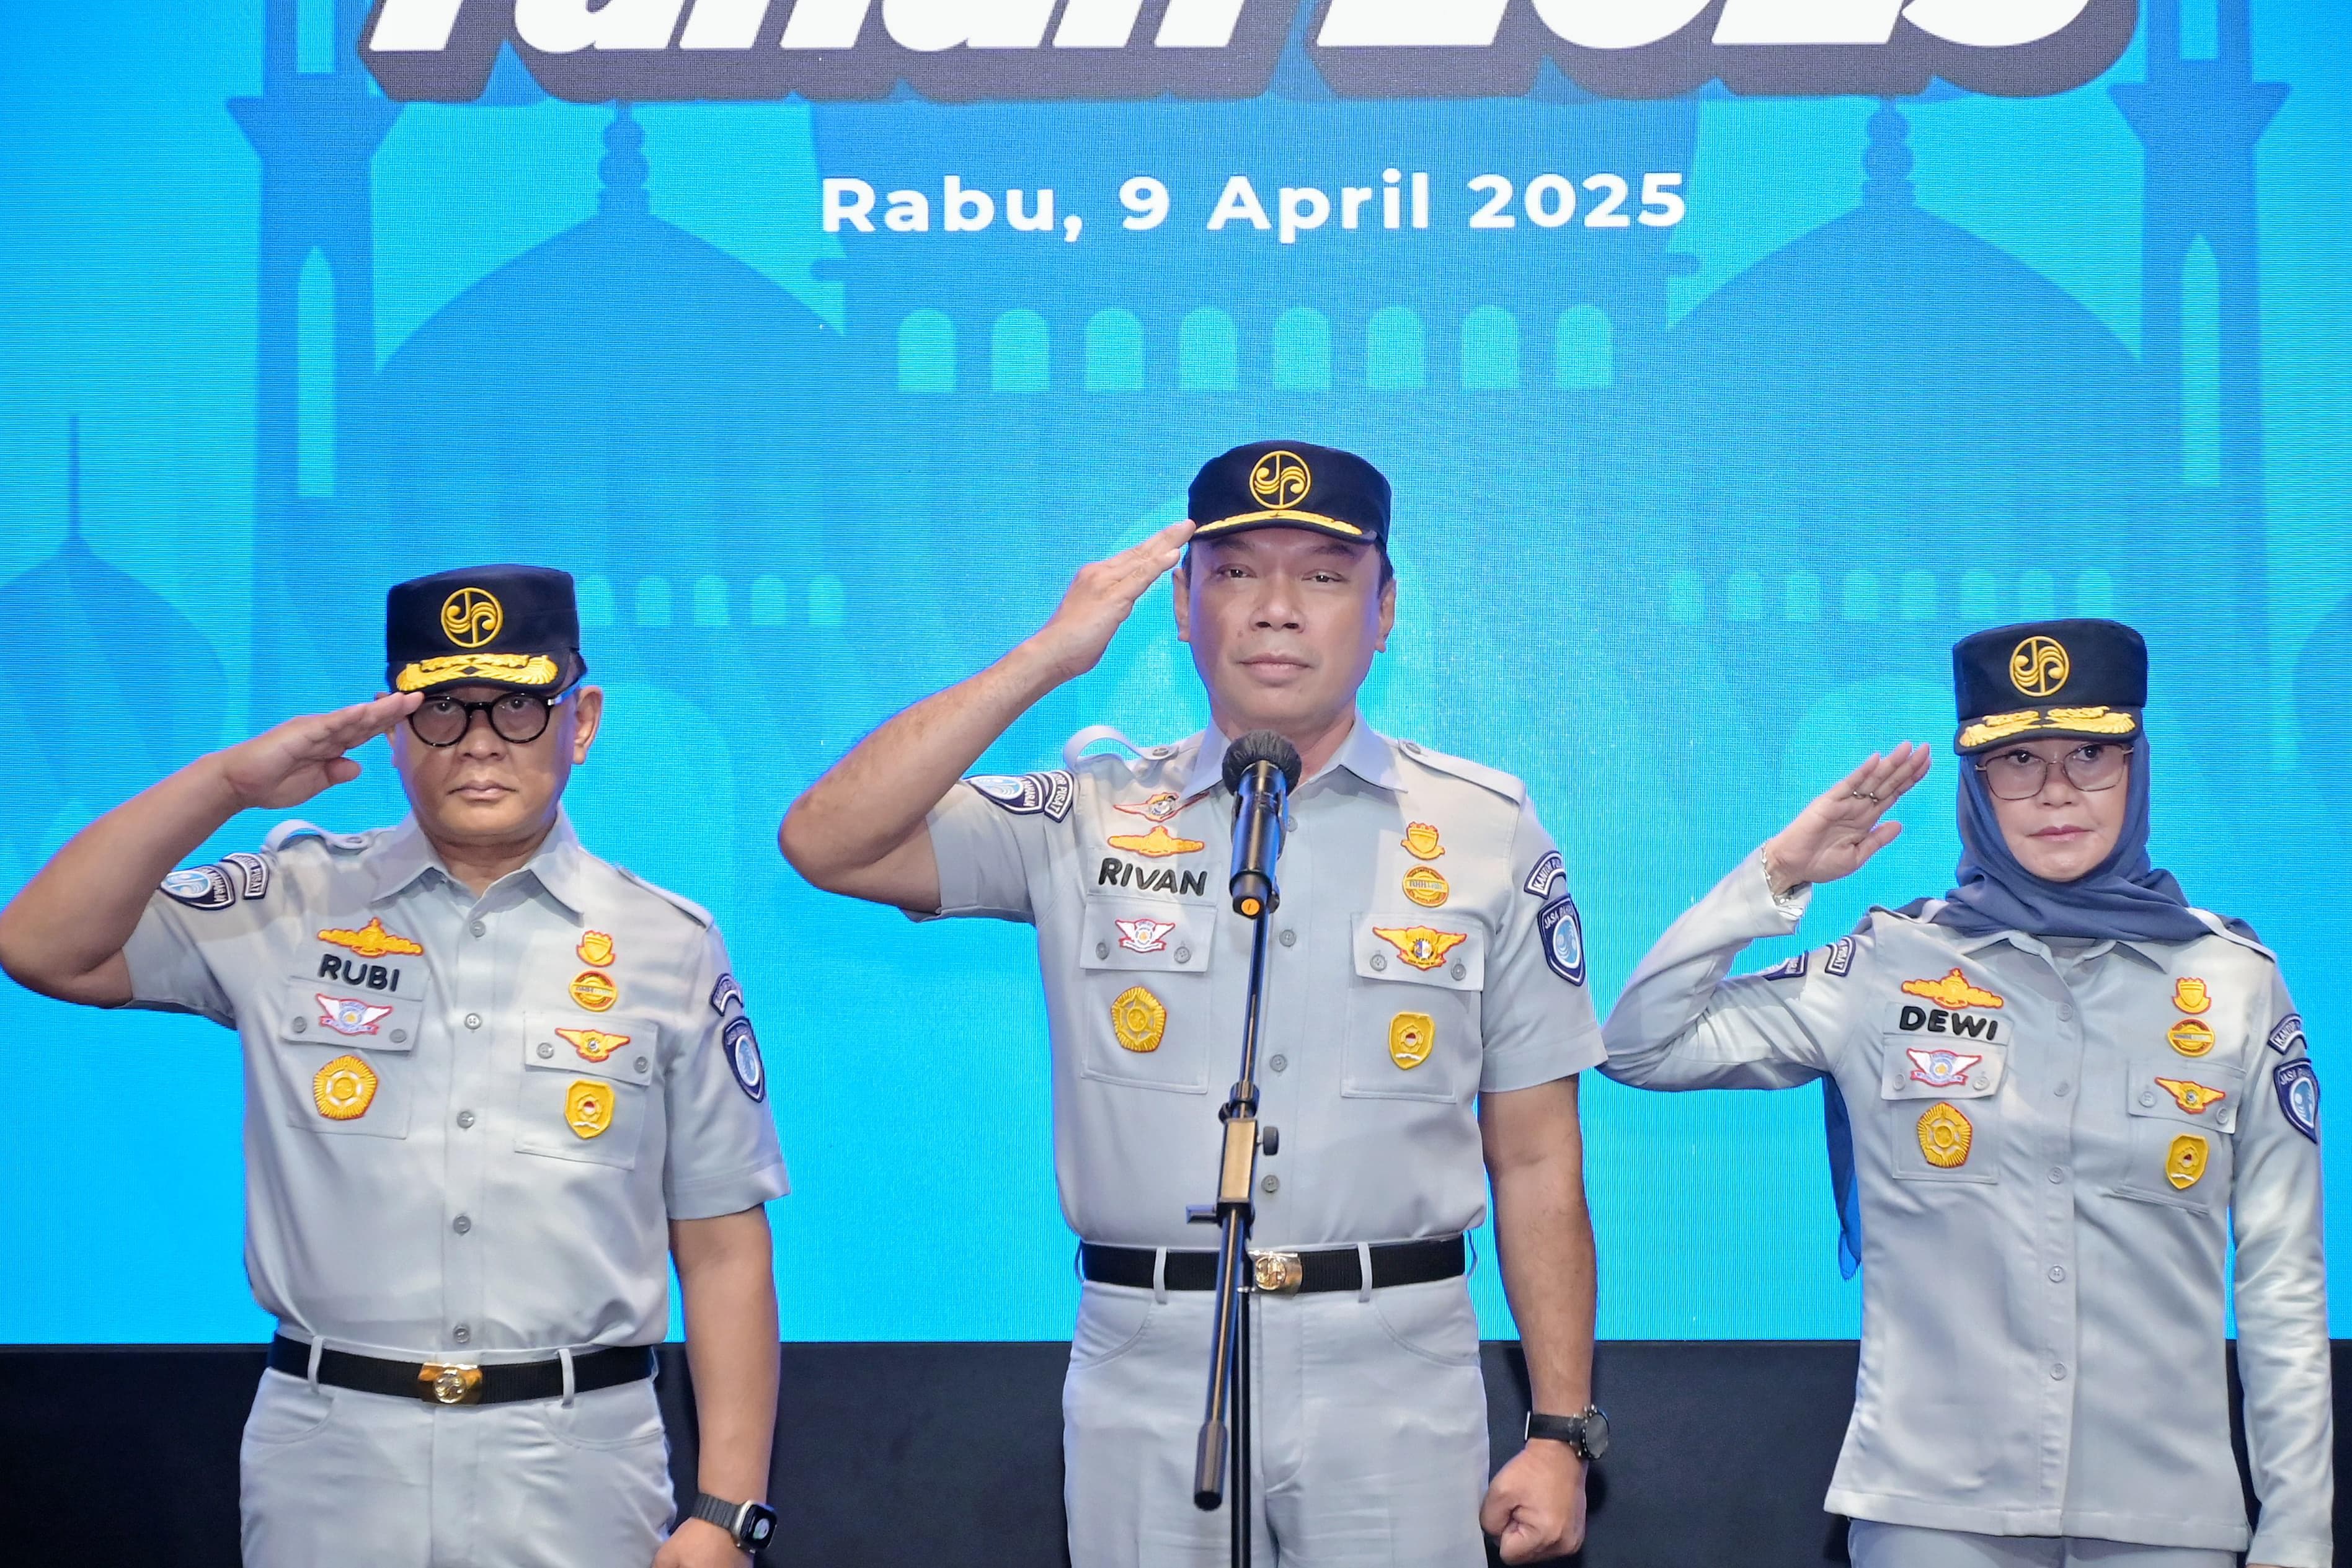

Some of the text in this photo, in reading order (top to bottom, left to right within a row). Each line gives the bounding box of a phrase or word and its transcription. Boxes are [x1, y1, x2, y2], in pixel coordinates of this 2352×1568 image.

[822, 168, 1686, 244] Rabu, 9 April 2025
[1050, 786, 1068, 813] PUSAT
[251, 867, 263, 893] PUSAT
[1098, 857, 1208, 897] RIVAN
[1544, 910, 1560, 929] JASA
[317, 954, 400, 992] RUBI
[1899, 1006, 1999, 1040] DEWI
